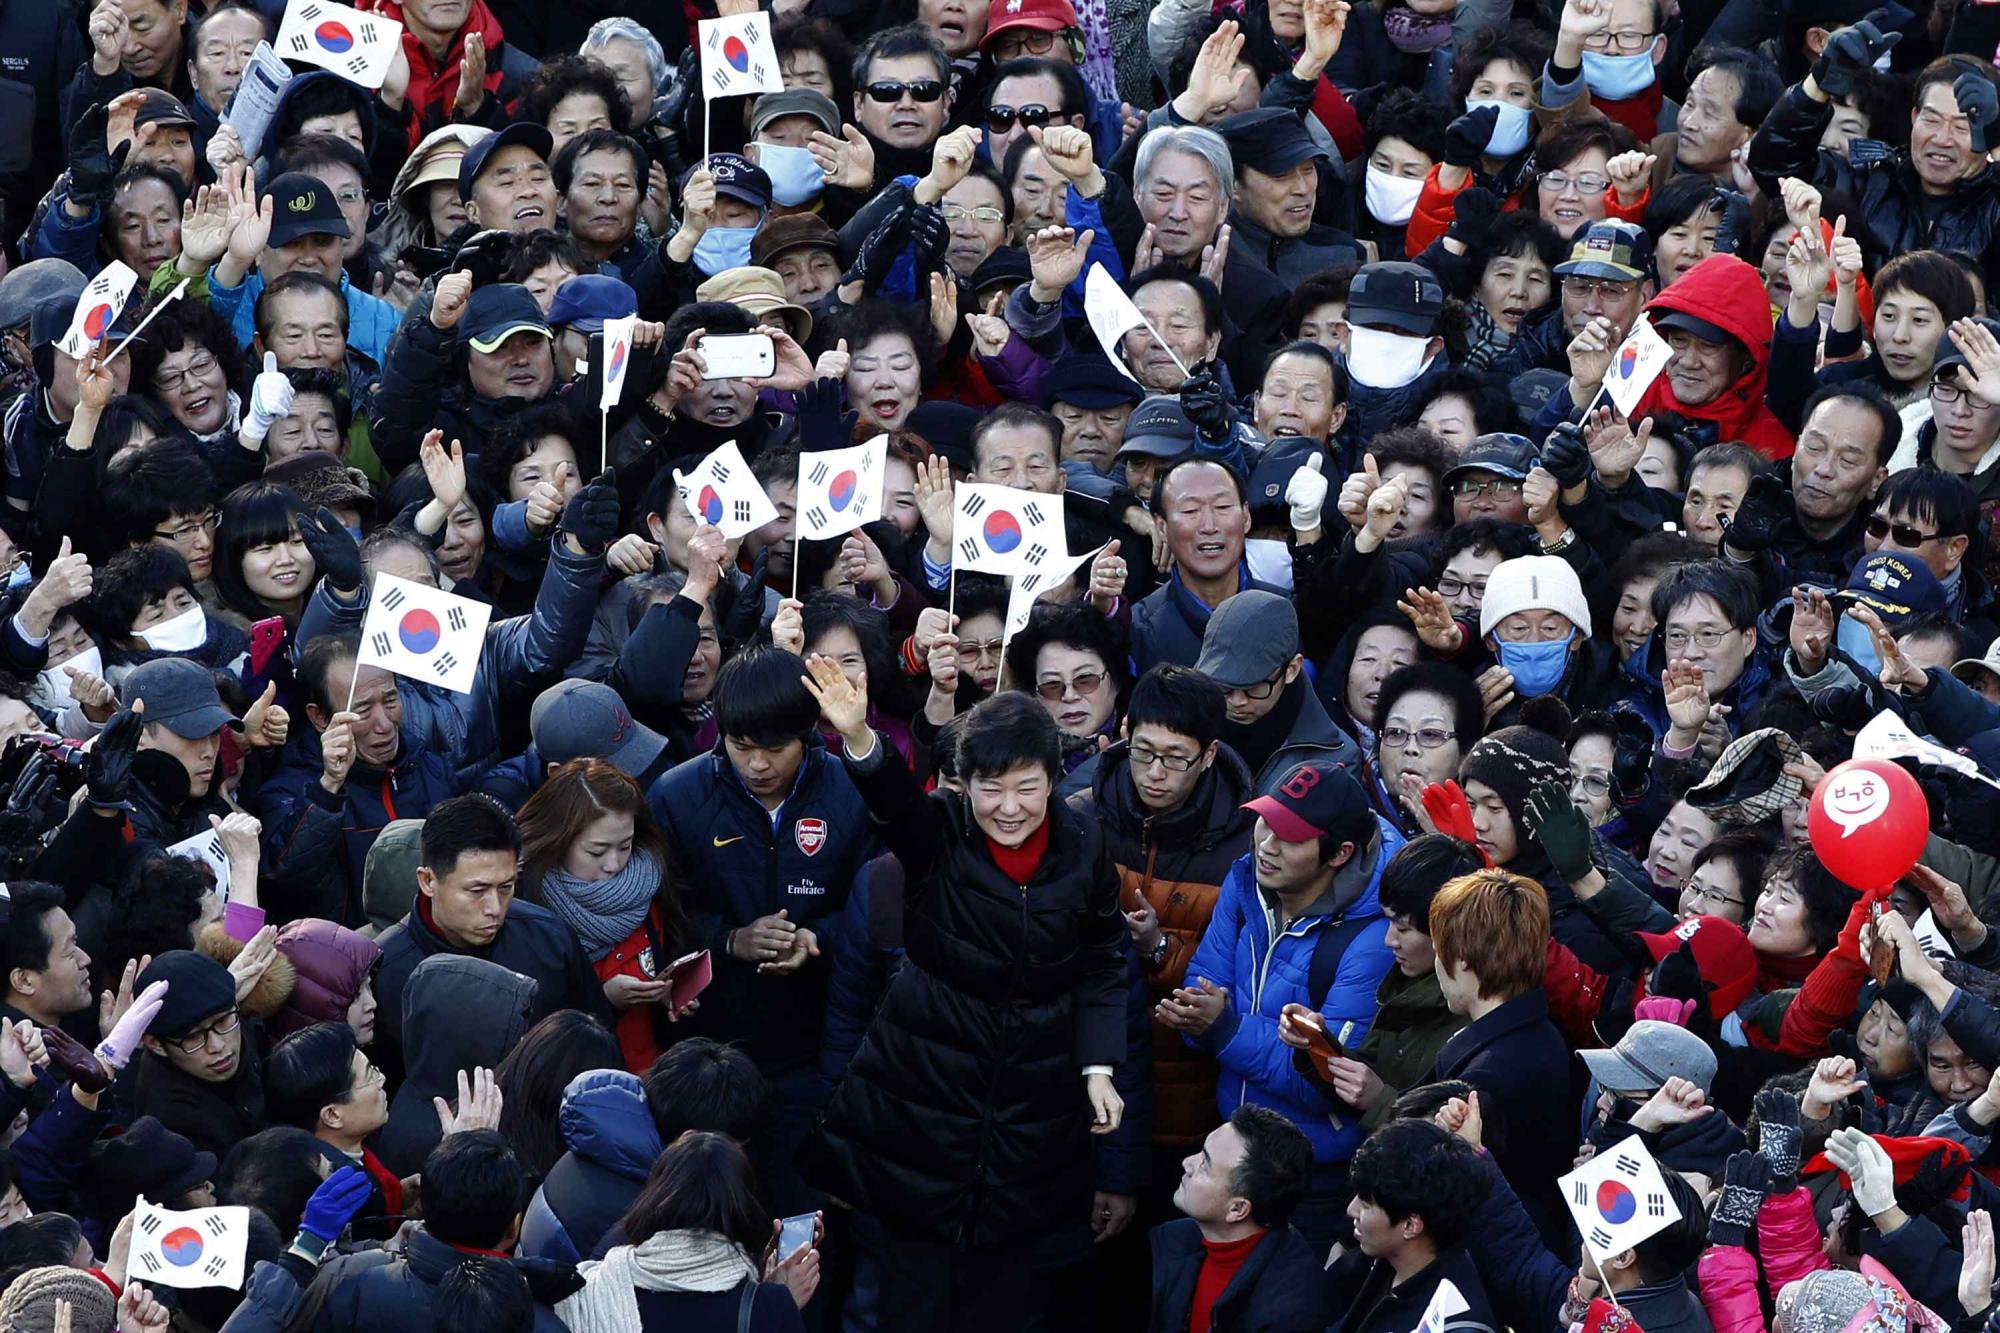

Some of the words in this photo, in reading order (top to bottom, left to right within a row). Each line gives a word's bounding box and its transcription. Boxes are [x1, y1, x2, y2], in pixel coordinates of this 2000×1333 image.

[1887, 558, 1912, 580] KOREA
[1280, 766, 1320, 799] B
[801, 878, 814, 887] Fly
